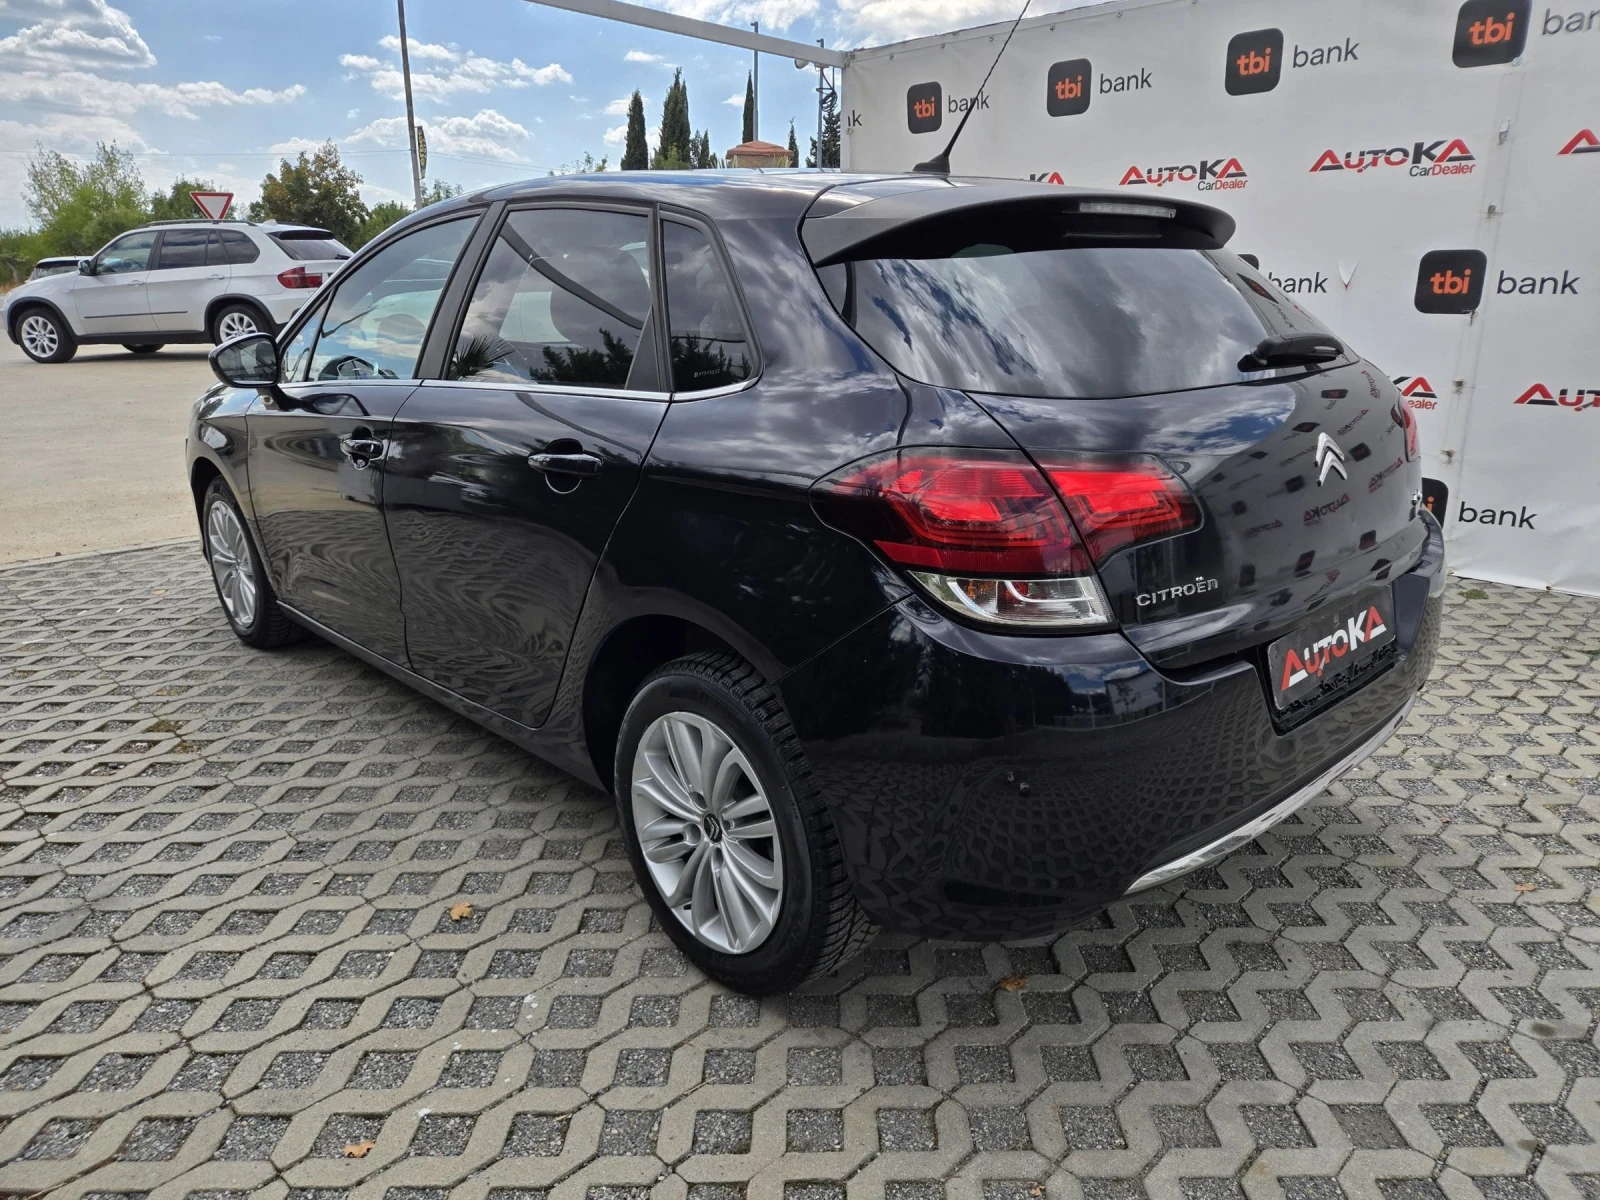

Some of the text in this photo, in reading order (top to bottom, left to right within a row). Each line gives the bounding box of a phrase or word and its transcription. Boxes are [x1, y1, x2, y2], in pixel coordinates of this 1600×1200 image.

[1468, 12, 1515, 45] tbi
[1236, 37, 1360, 75] tbi bank
[1055, 67, 1153, 100] tbi bank
[913, 96, 935, 118] tbi
[1409, 162, 1476, 177] CarDealer
[1197, 179, 1248, 191] CarDealer
[1430, 268, 1581, 295] tbi bank
[1458, 501, 1538, 530] bank
